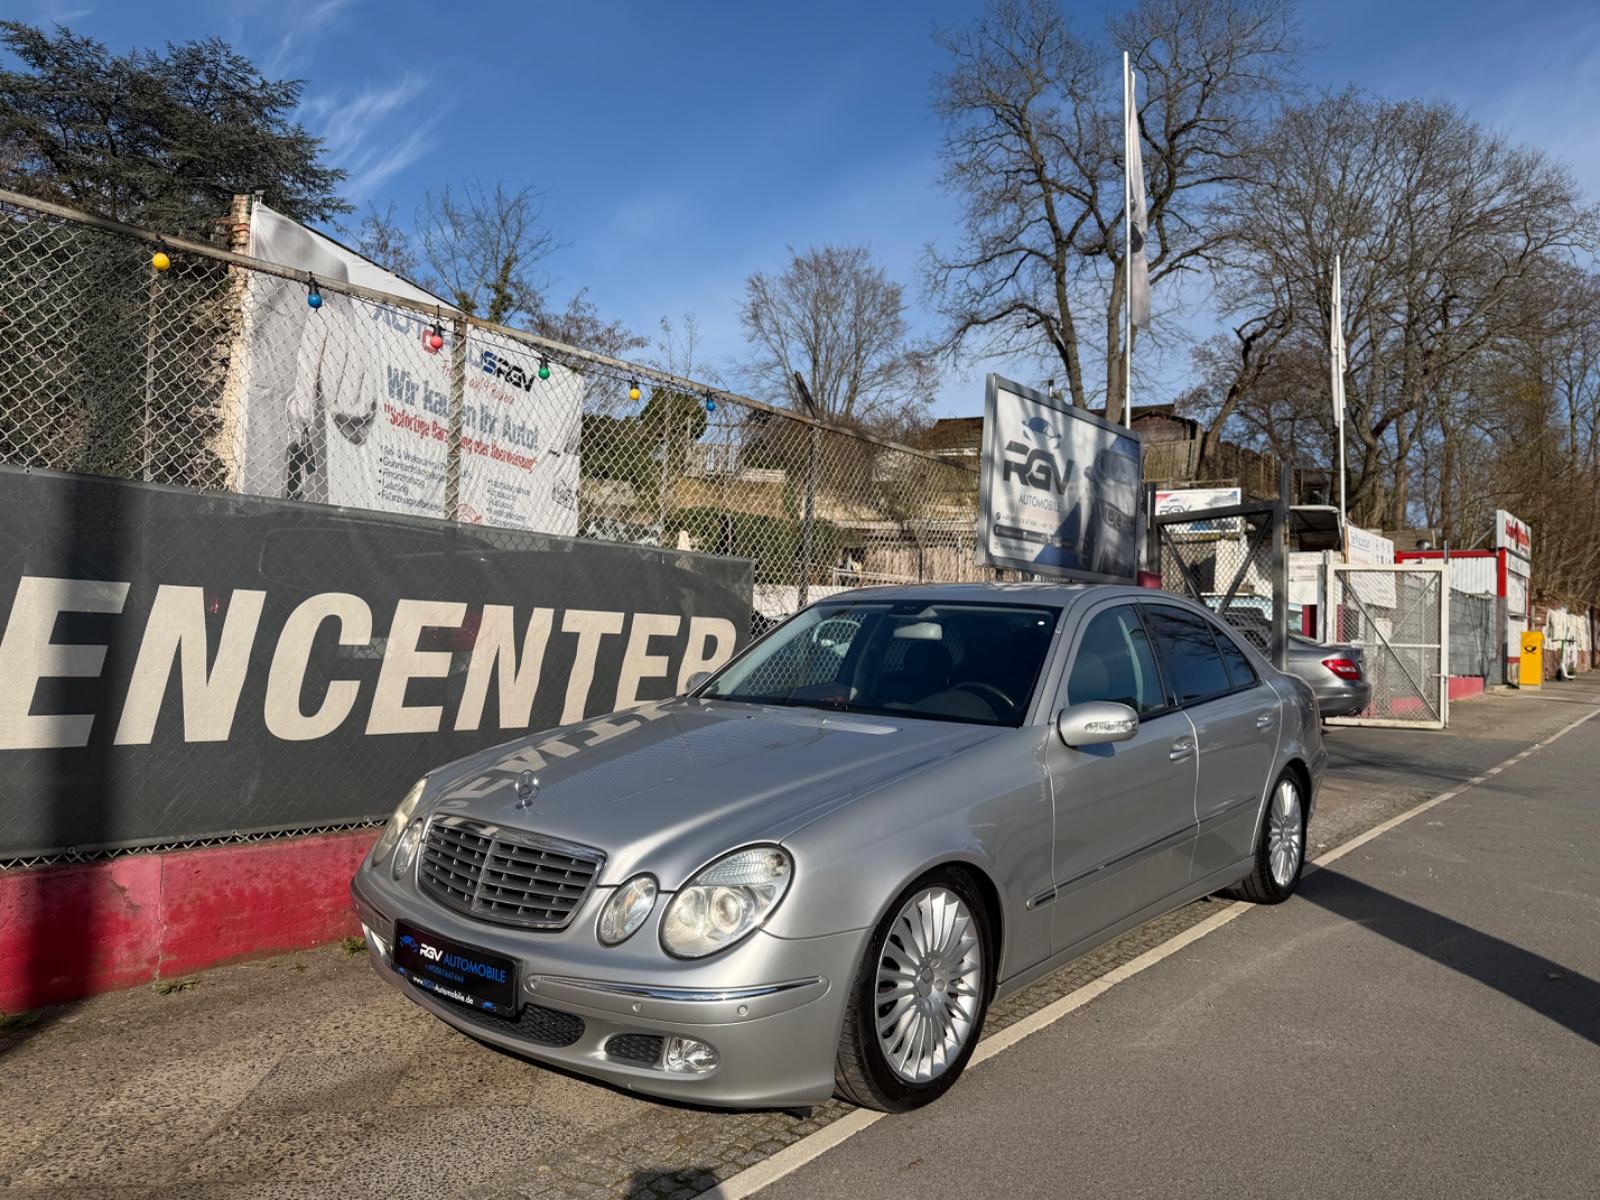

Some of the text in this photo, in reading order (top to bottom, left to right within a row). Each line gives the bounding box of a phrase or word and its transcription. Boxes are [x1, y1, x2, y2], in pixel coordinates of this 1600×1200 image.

[386, 364, 420, 406] Wir
[502, 415, 540, 453] Auto!
[1003, 440, 1075, 495] RGV
[1019, 493, 1061, 513] AUTOMOBILE
[419, 942, 507, 984] RGV AUTOMOBILE
